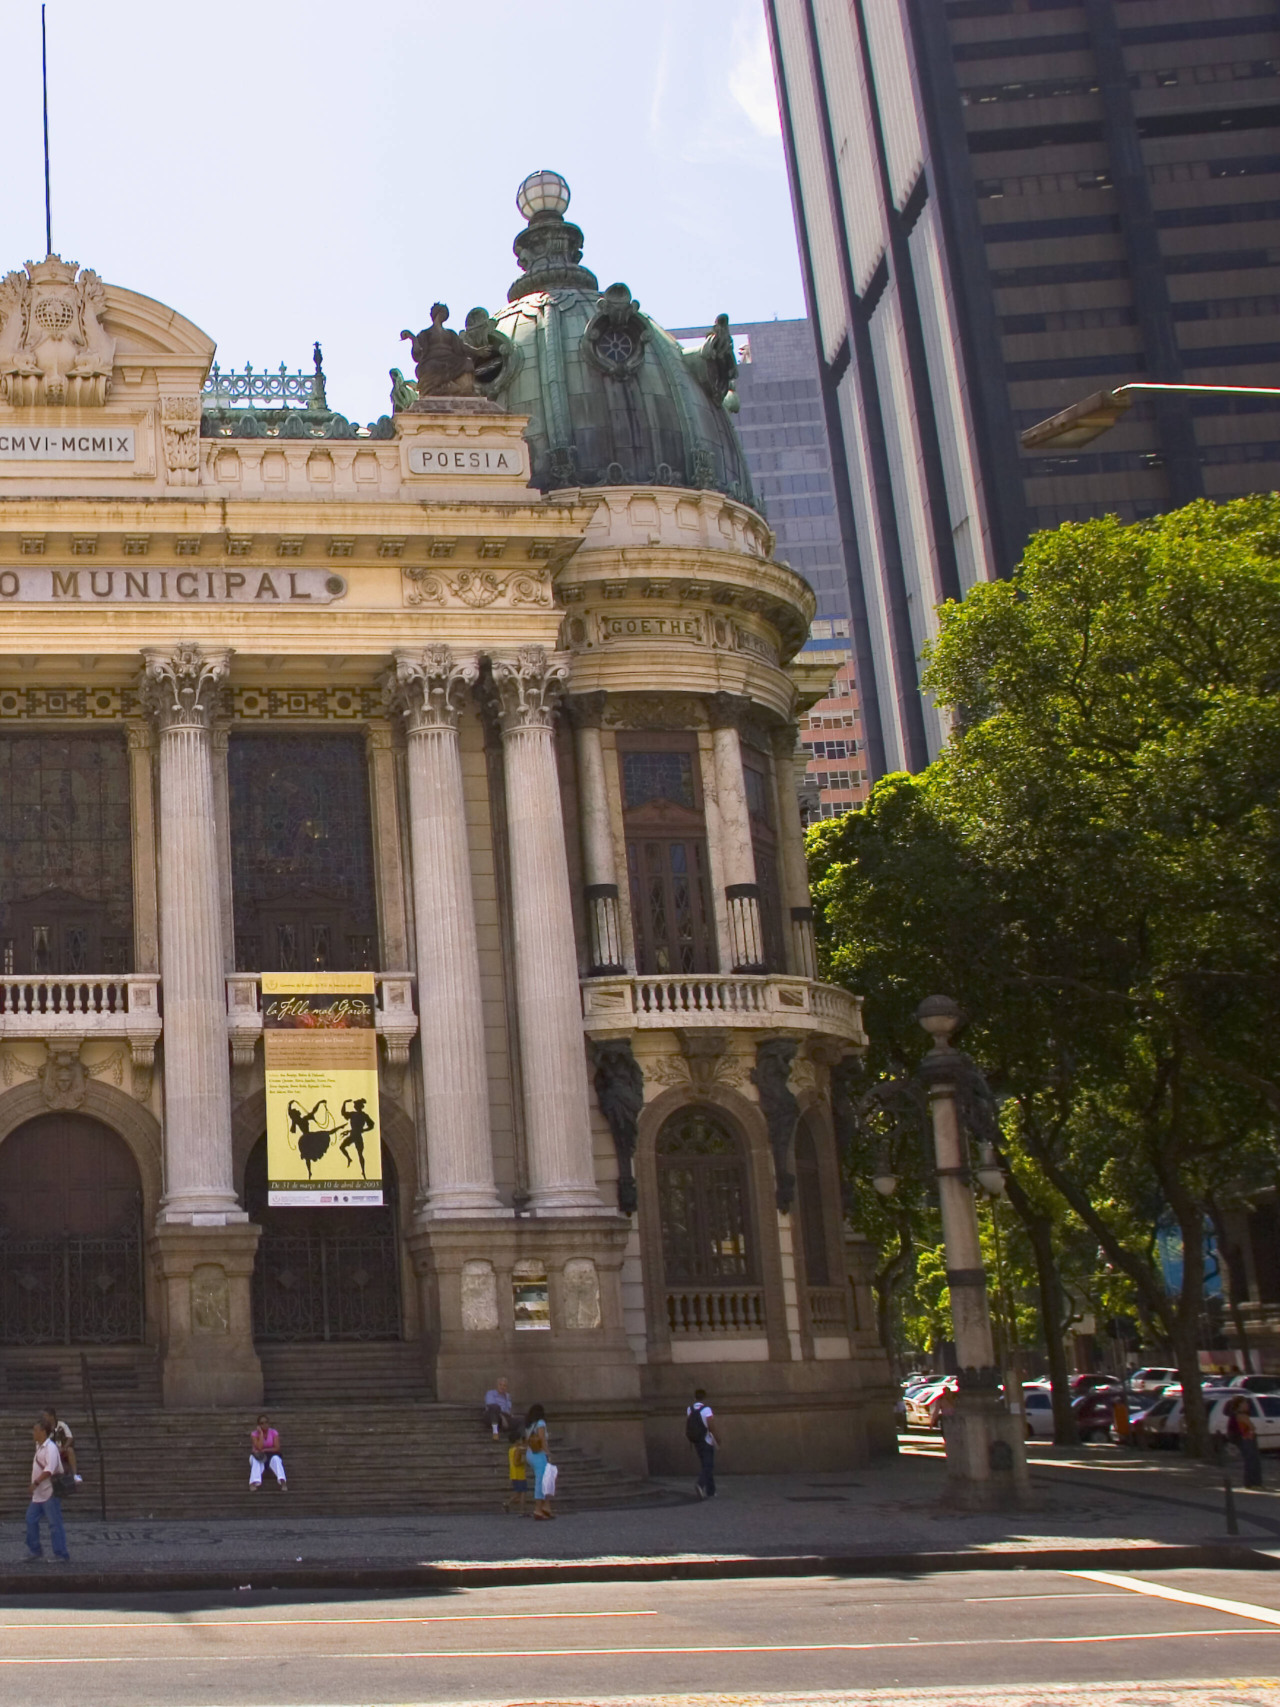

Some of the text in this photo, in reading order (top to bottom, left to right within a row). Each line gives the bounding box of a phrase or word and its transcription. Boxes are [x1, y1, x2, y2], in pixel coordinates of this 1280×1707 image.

[422, 452, 508, 468] POESIA
[50, 570, 312, 599] MUNICIPAL
[612, 620, 694, 635] GOETHE
[312, 1000, 339, 1016] mal
